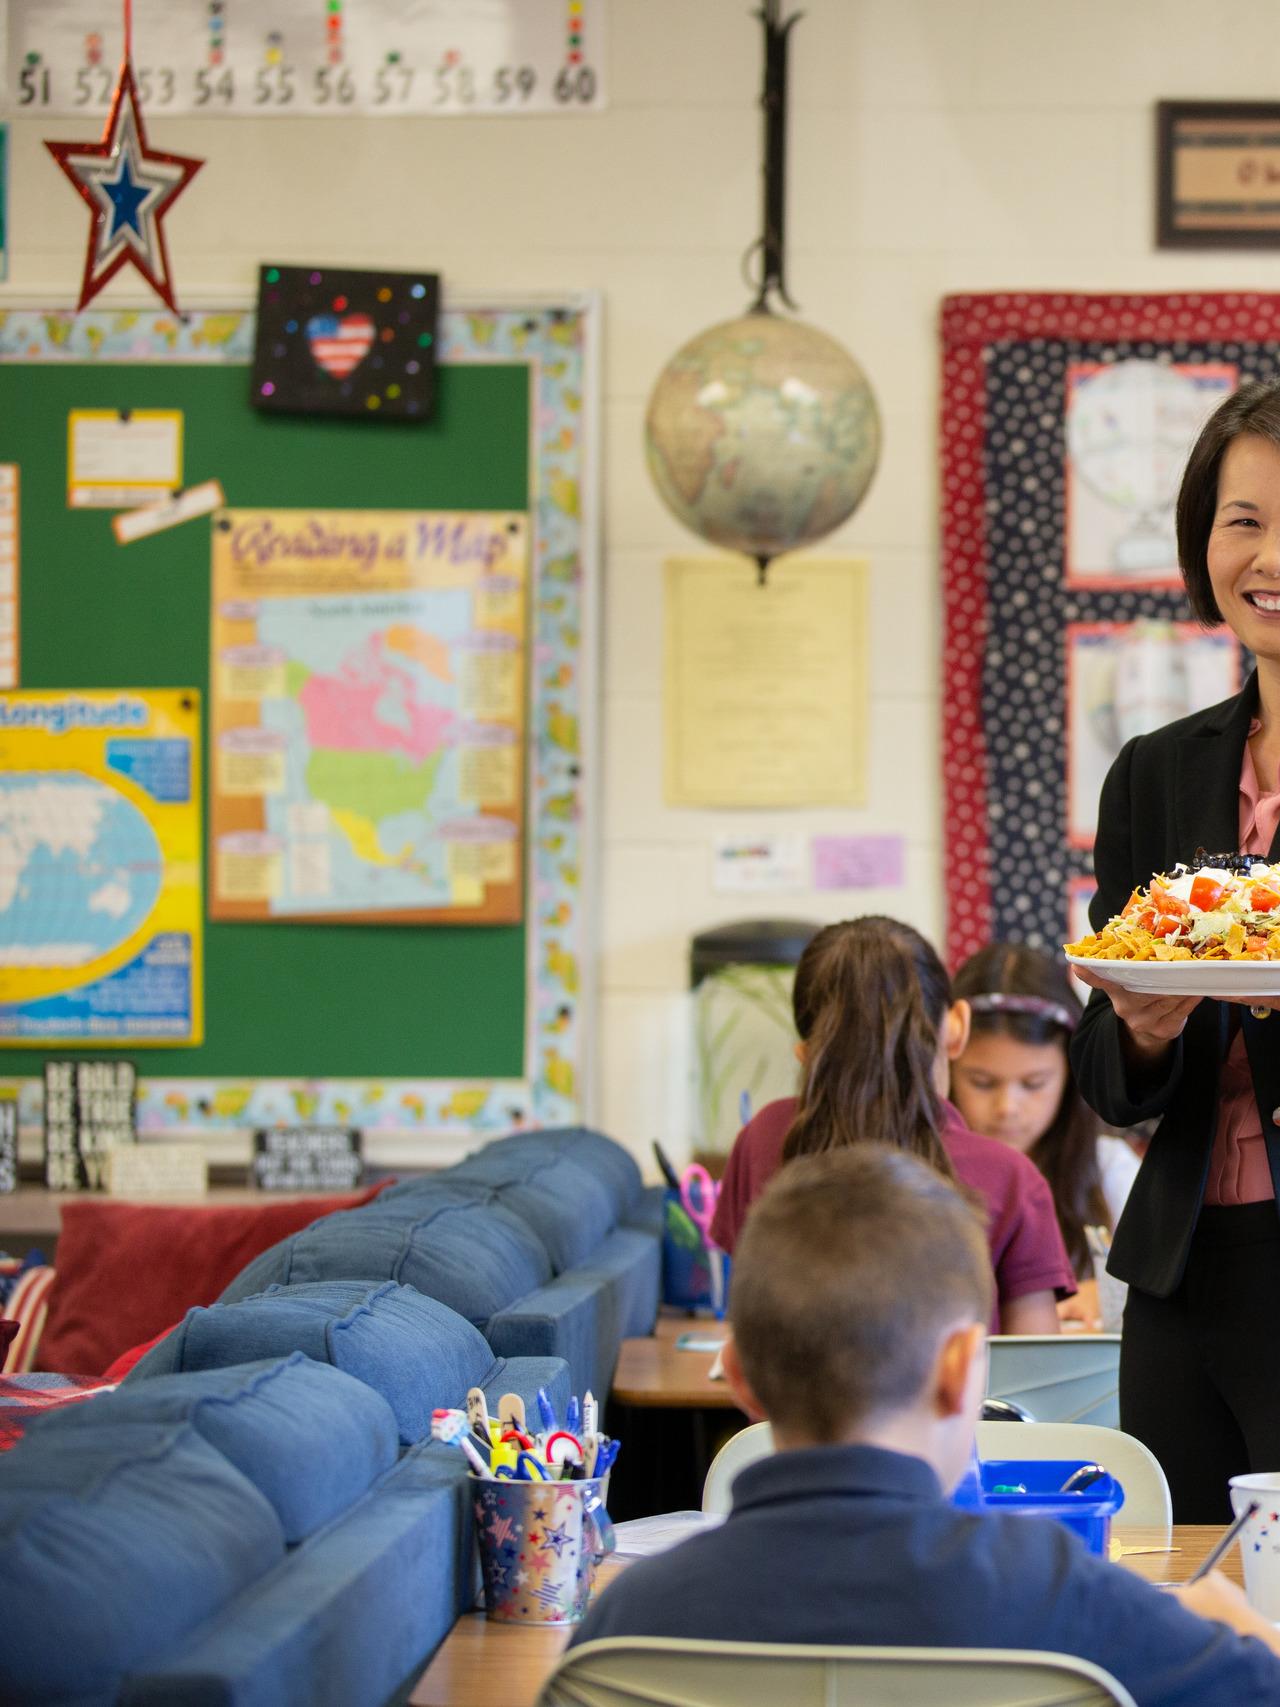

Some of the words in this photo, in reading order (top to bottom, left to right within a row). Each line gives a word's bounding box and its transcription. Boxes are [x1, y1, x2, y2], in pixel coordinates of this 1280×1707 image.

[19, 69, 52, 105] 51
[75, 67, 113, 105] 52
[138, 67, 176, 105] 53
[194, 66, 235, 105] 54
[253, 66, 294, 105] 55
[315, 66, 357, 104] 56
[373, 67, 416, 104] 57
[433, 67, 475, 104] 58
[492, 66, 537, 104] 59
[553, 67, 598, 103] 60
[231, 519, 378, 571] Reading
[417, 520, 508, 572] Map
